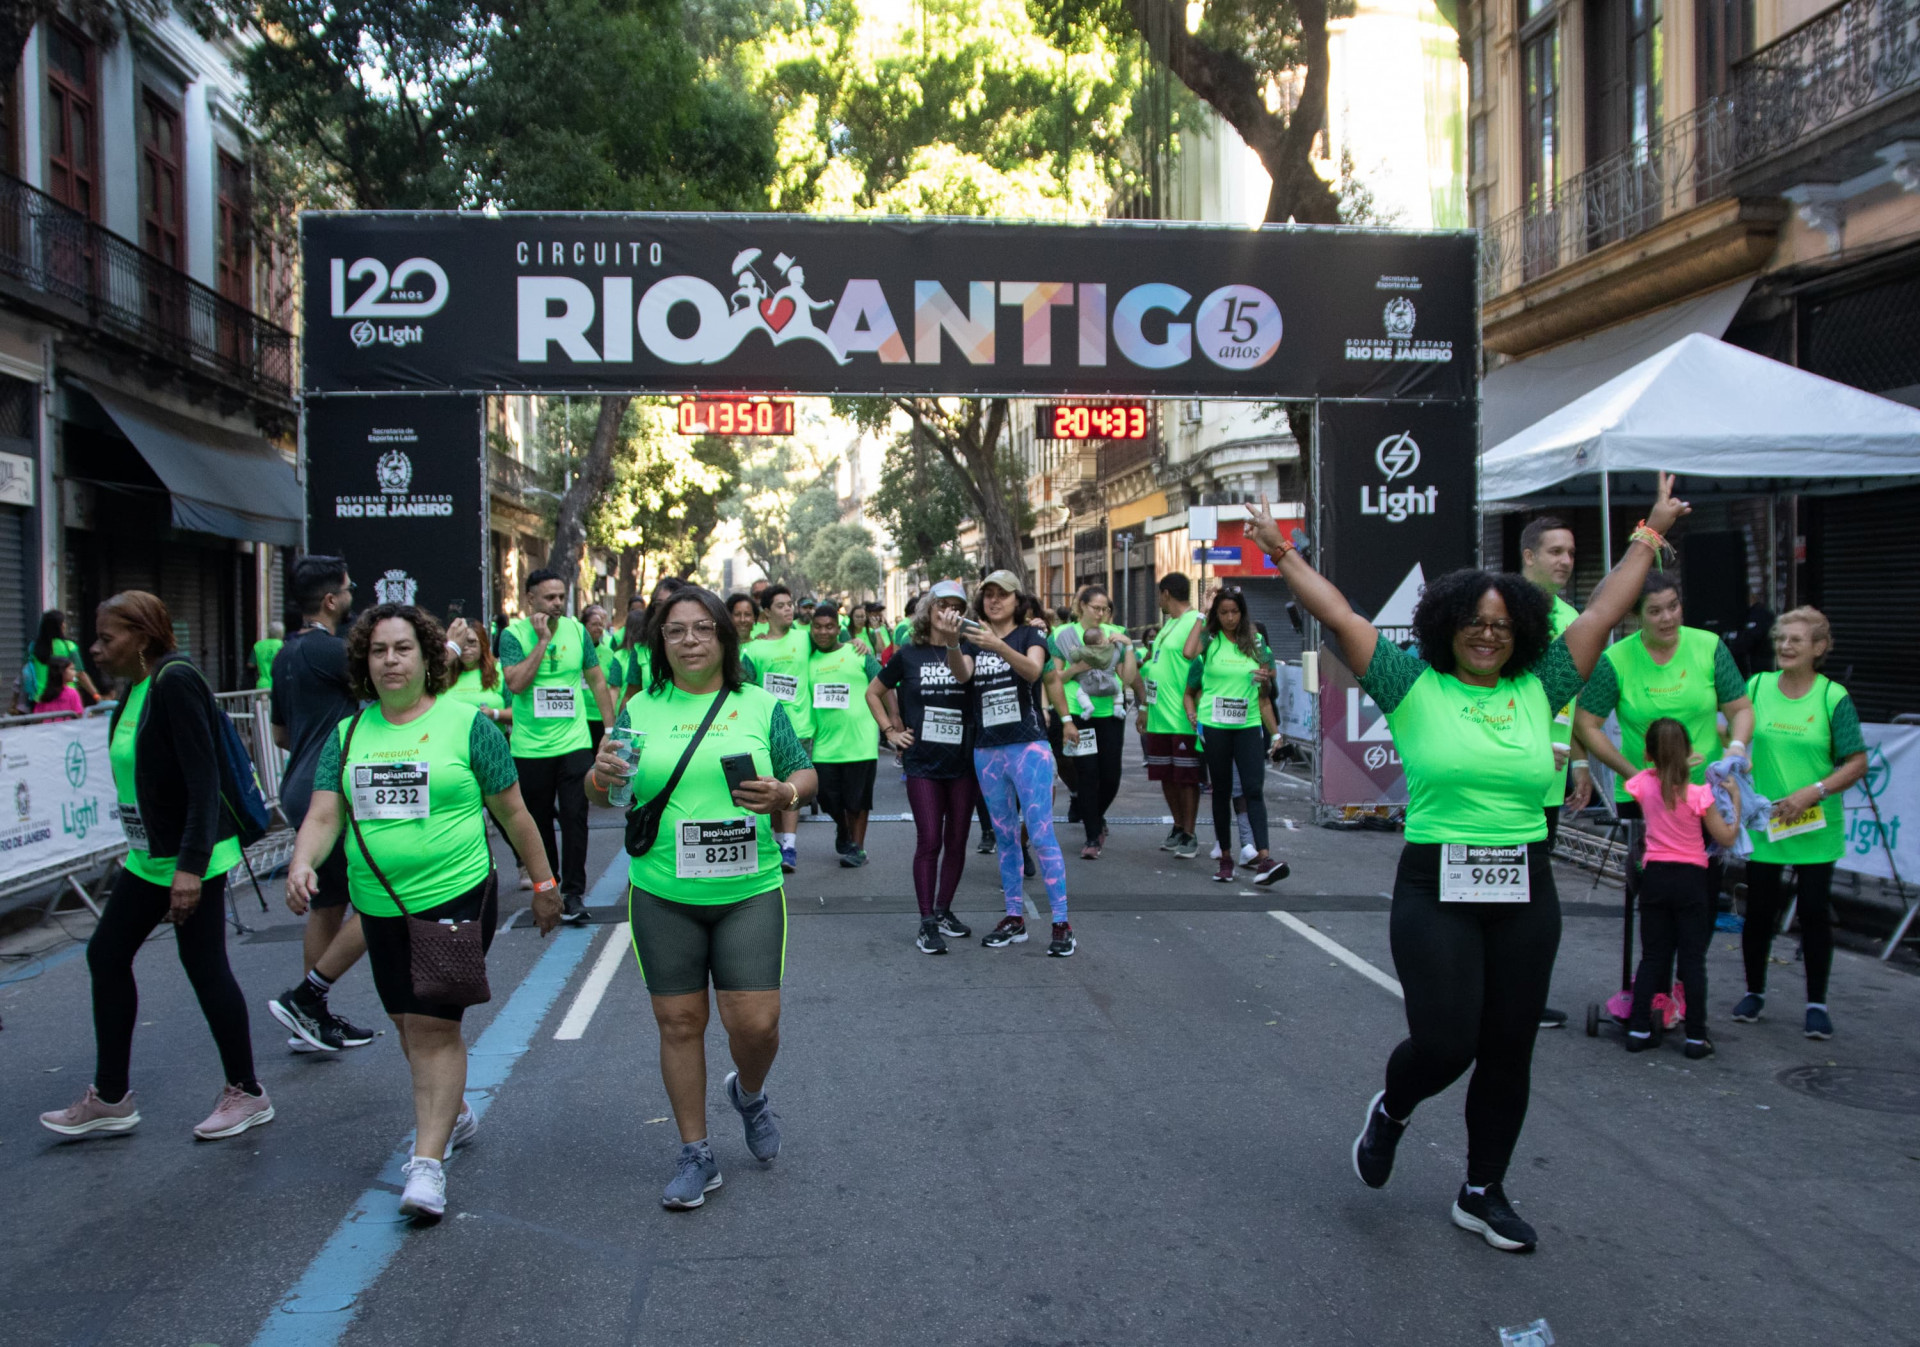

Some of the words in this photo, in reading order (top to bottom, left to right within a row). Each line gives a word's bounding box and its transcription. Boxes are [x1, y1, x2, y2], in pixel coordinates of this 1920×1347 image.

[516, 241, 662, 265] CIRCUITO
[330, 257, 449, 318] 120
[390, 290, 424, 300] ANOS
[517, 275, 729, 365] RIO
[1219, 296, 1261, 343] 15
[378, 325, 424, 346] Light
[1218, 344, 1261, 359] anos
[1415, 341, 1453, 349] ESTADO
[1345, 347, 1372, 360] RIO
[1373, 348, 1392, 360] DE
[1394, 348, 1453, 362] JANEIRO
[336, 496, 388, 504] GOVERNO
[411, 495, 453, 503] ESTADO
[1361, 485, 1439, 522] Light
[336, 504, 364, 517] RIO
[365, 504, 387, 517] DE
[388, 503, 453, 517] JANEIRO
[920, 666, 949, 678] RIO
[547, 701, 574, 710] 10953
[991, 703, 1017, 716] 1554
[935, 724, 961, 735] 1553
[372, 749, 420, 758] PREGUIÇA
[375, 788, 419, 805] 8232
[62, 797, 98, 839] Light
[1844, 808, 1901, 855] ight
[705, 845, 747, 863] 8231
[1471, 868, 1520, 885] 9692
